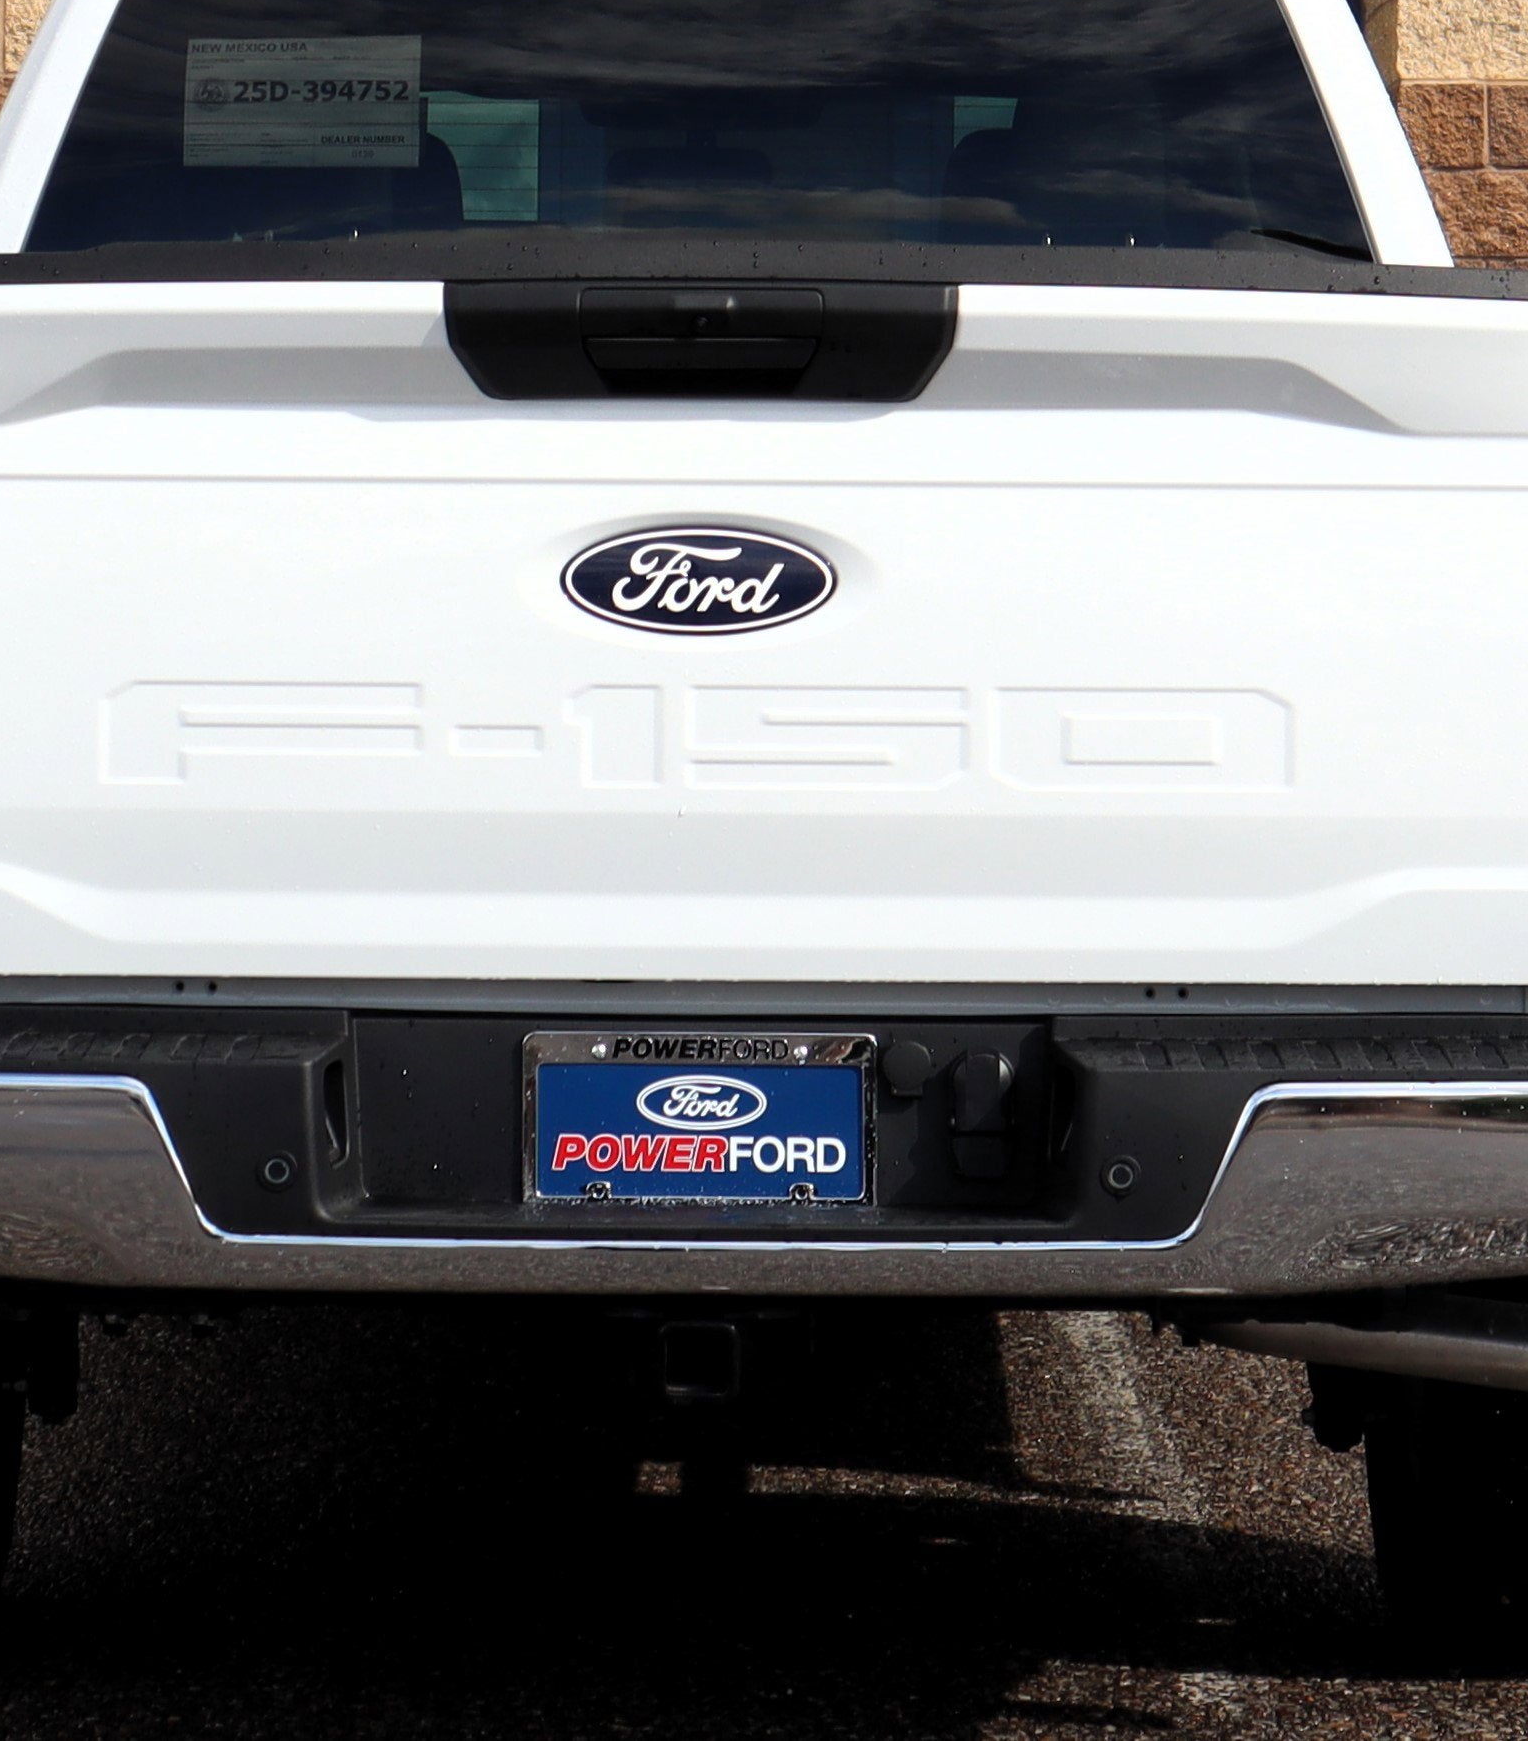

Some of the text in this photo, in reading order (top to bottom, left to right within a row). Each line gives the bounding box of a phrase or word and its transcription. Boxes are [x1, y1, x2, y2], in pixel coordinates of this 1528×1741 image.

[192, 43, 307, 52] NEW MEXICO USA
[234, 80, 409, 102] 25D-394752
[321, 135, 405, 143] DEALER NUMBER
[610, 541, 781, 617] Ford
[98, 678, 1296, 793] F-150
[612, 1038, 790, 1060] POWERFORD
[663, 1085, 739, 1117] Ford
[551, 1133, 847, 1173] POWERFORD
